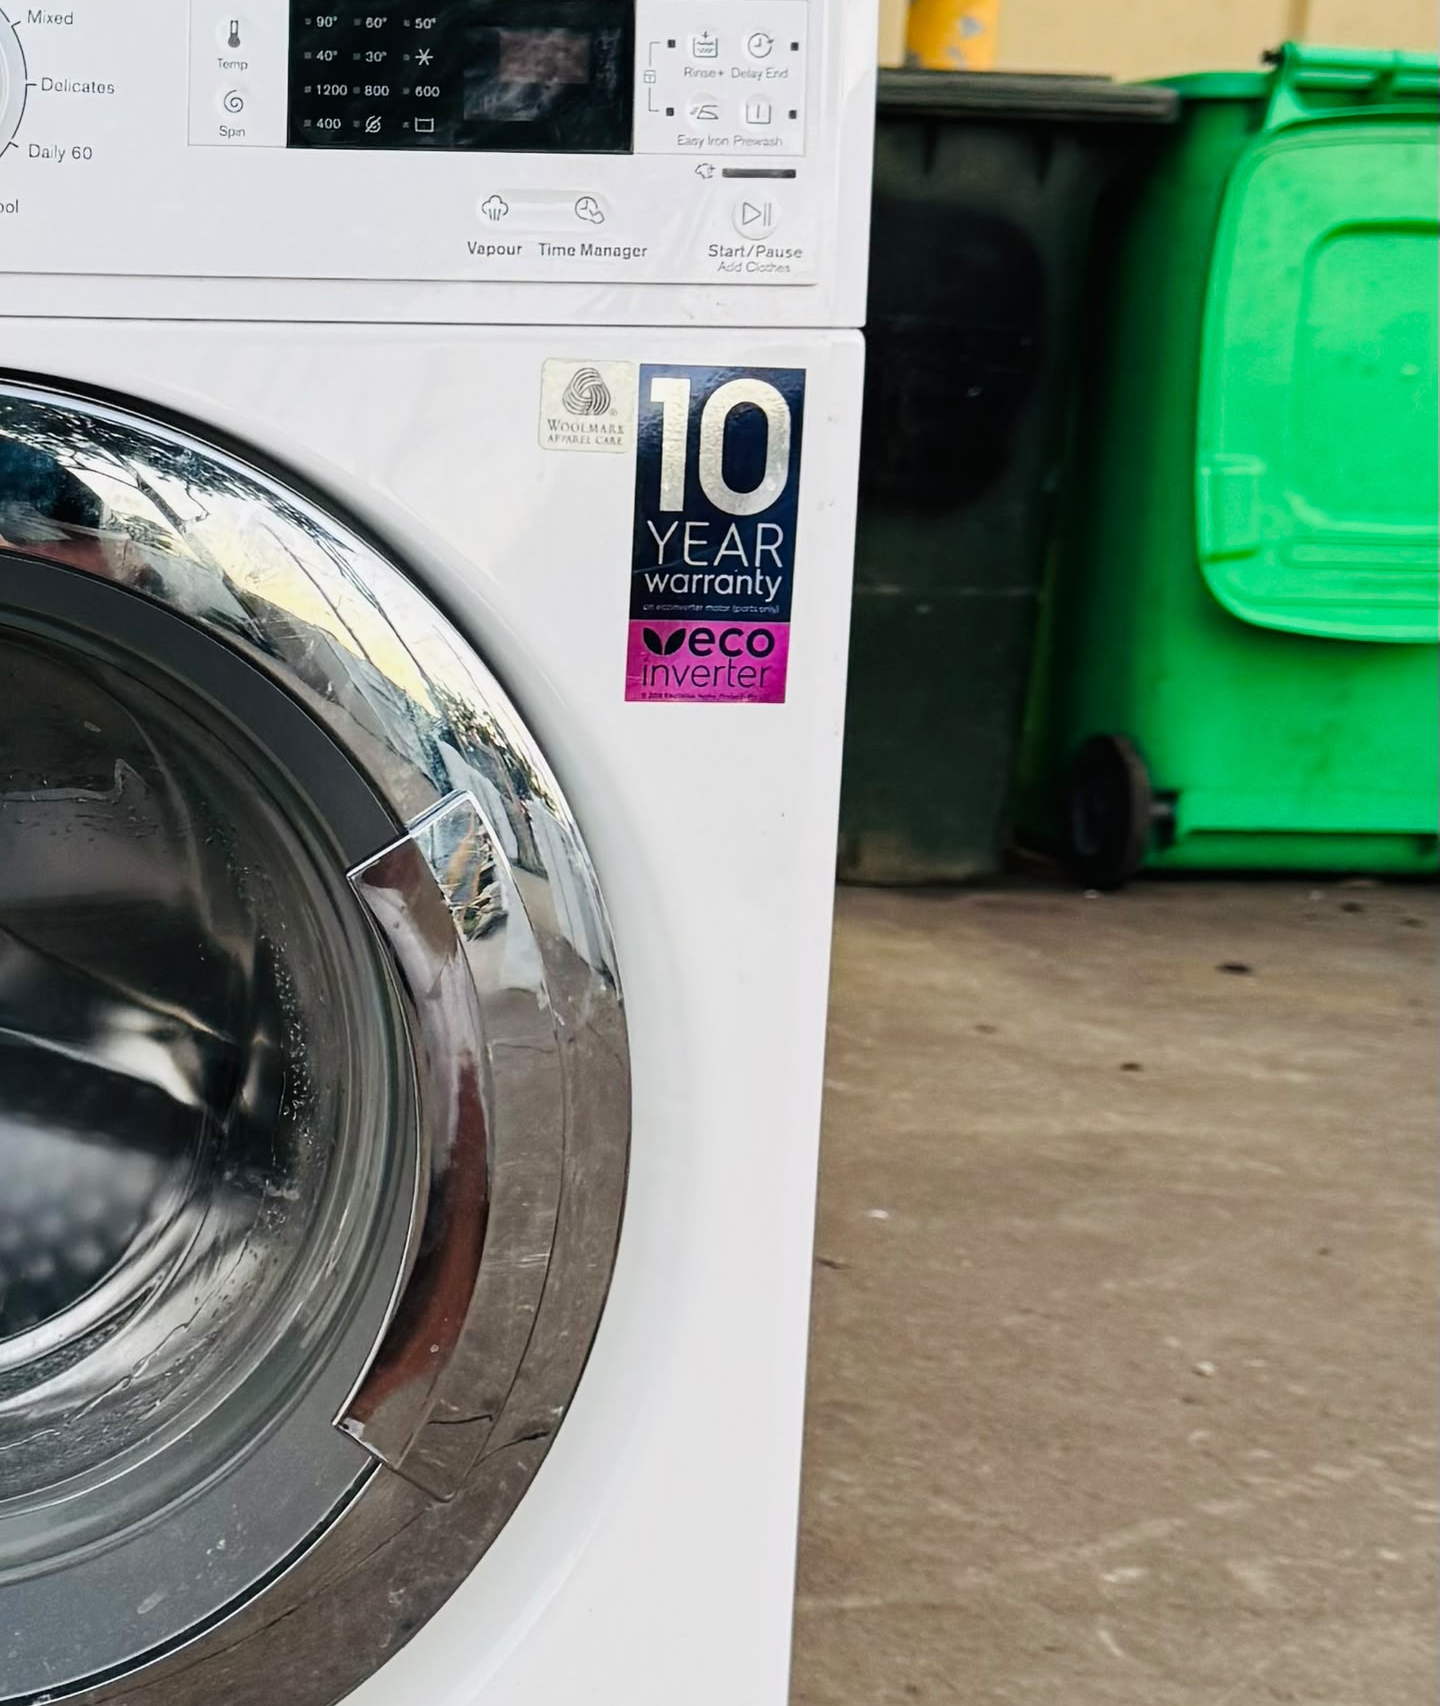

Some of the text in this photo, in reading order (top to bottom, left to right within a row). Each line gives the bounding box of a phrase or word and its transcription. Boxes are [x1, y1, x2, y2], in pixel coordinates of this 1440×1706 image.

[27, 10, 74, 25] Mixed
[218, 58, 248, 71] Temp
[766, 68, 788, 78] End
[41, 78, 115, 95] Delicates
[316, 84, 347, 95] 1200
[365, 85, 389, 96] 800
[415, 86, 440, 97] 600
[316, 118, 341, 128] 400
[219, 125, 245, 138] Spin
[678, 134, 728, 149] Easy Iron
[29, 145, 92, 162] Daily 60
[467, 241, 522, 257] Vapour
[538, 243, 647, 259] Time Manager
[708, 245, 803, 259] Start/Pause
[548, 419, 624, 434] WOOLMARK
[650, 378, 791, 516] 10
[647, 520, 784, 567] YEAR
[645, 569, 782, 602] warranty
[689, 627, 775, 658] eco
[643, 658, 772, 687] inverter
